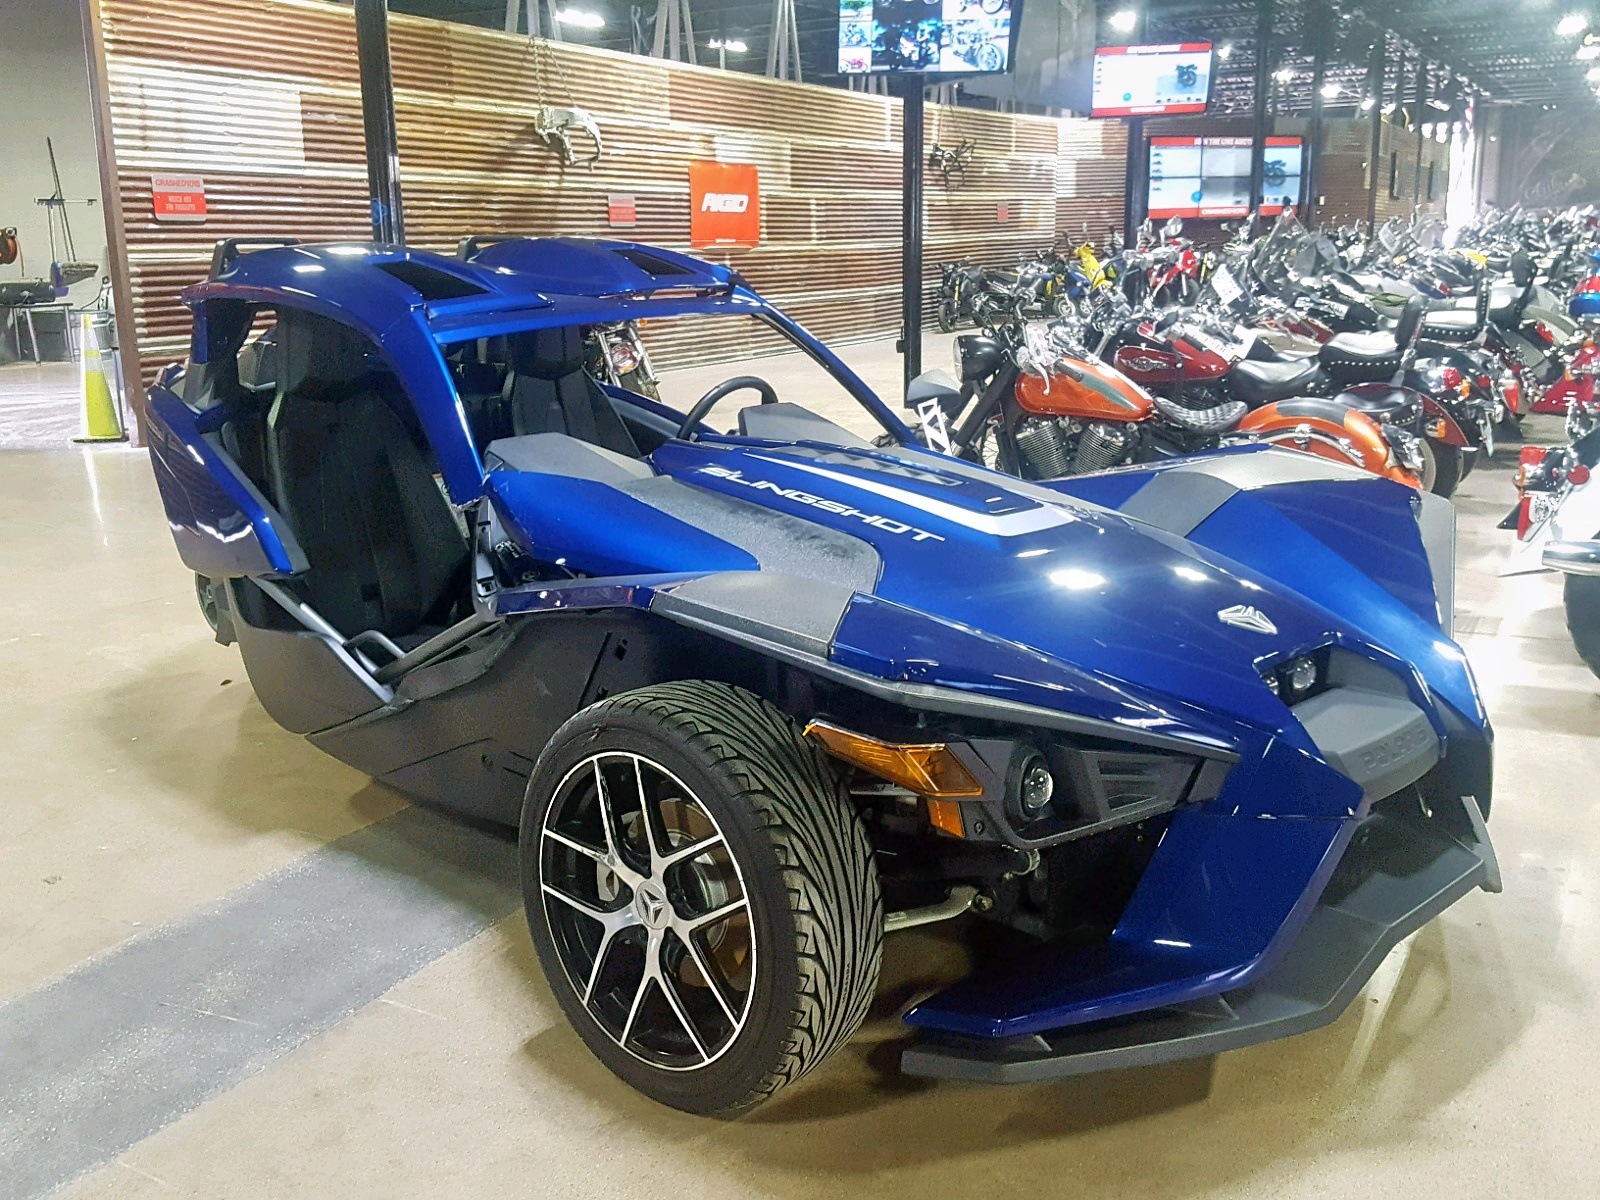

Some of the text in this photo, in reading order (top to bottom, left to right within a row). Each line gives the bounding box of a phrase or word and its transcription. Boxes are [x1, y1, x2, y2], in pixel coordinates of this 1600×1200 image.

[1194, 137, 1208, 146] JON
[698, 466, 946, 542] SLINGSHOT
[1360, 724, 1430, 774] POLARIS
